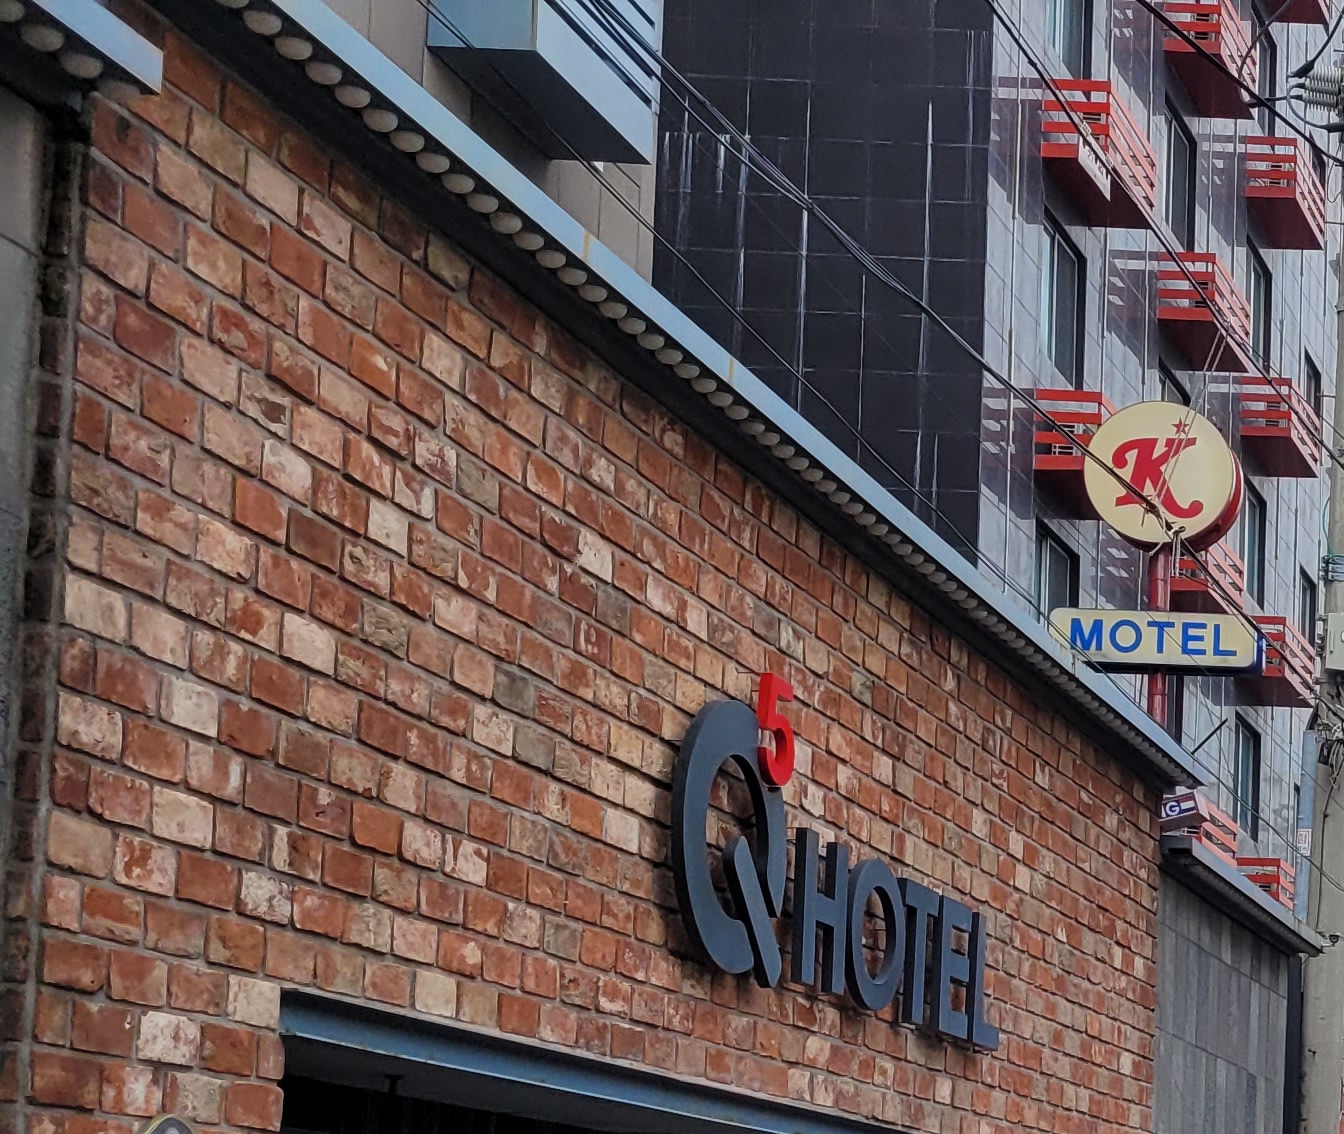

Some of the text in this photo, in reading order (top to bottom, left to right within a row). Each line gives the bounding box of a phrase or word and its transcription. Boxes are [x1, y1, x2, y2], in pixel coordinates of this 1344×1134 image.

[1112, 434, 1203, 519] K
[1069, 617, 1238, 660] MOTEL
[756, 673, 794, 787] 5
[672, 699, 1000, 1051] Q HOTEL
